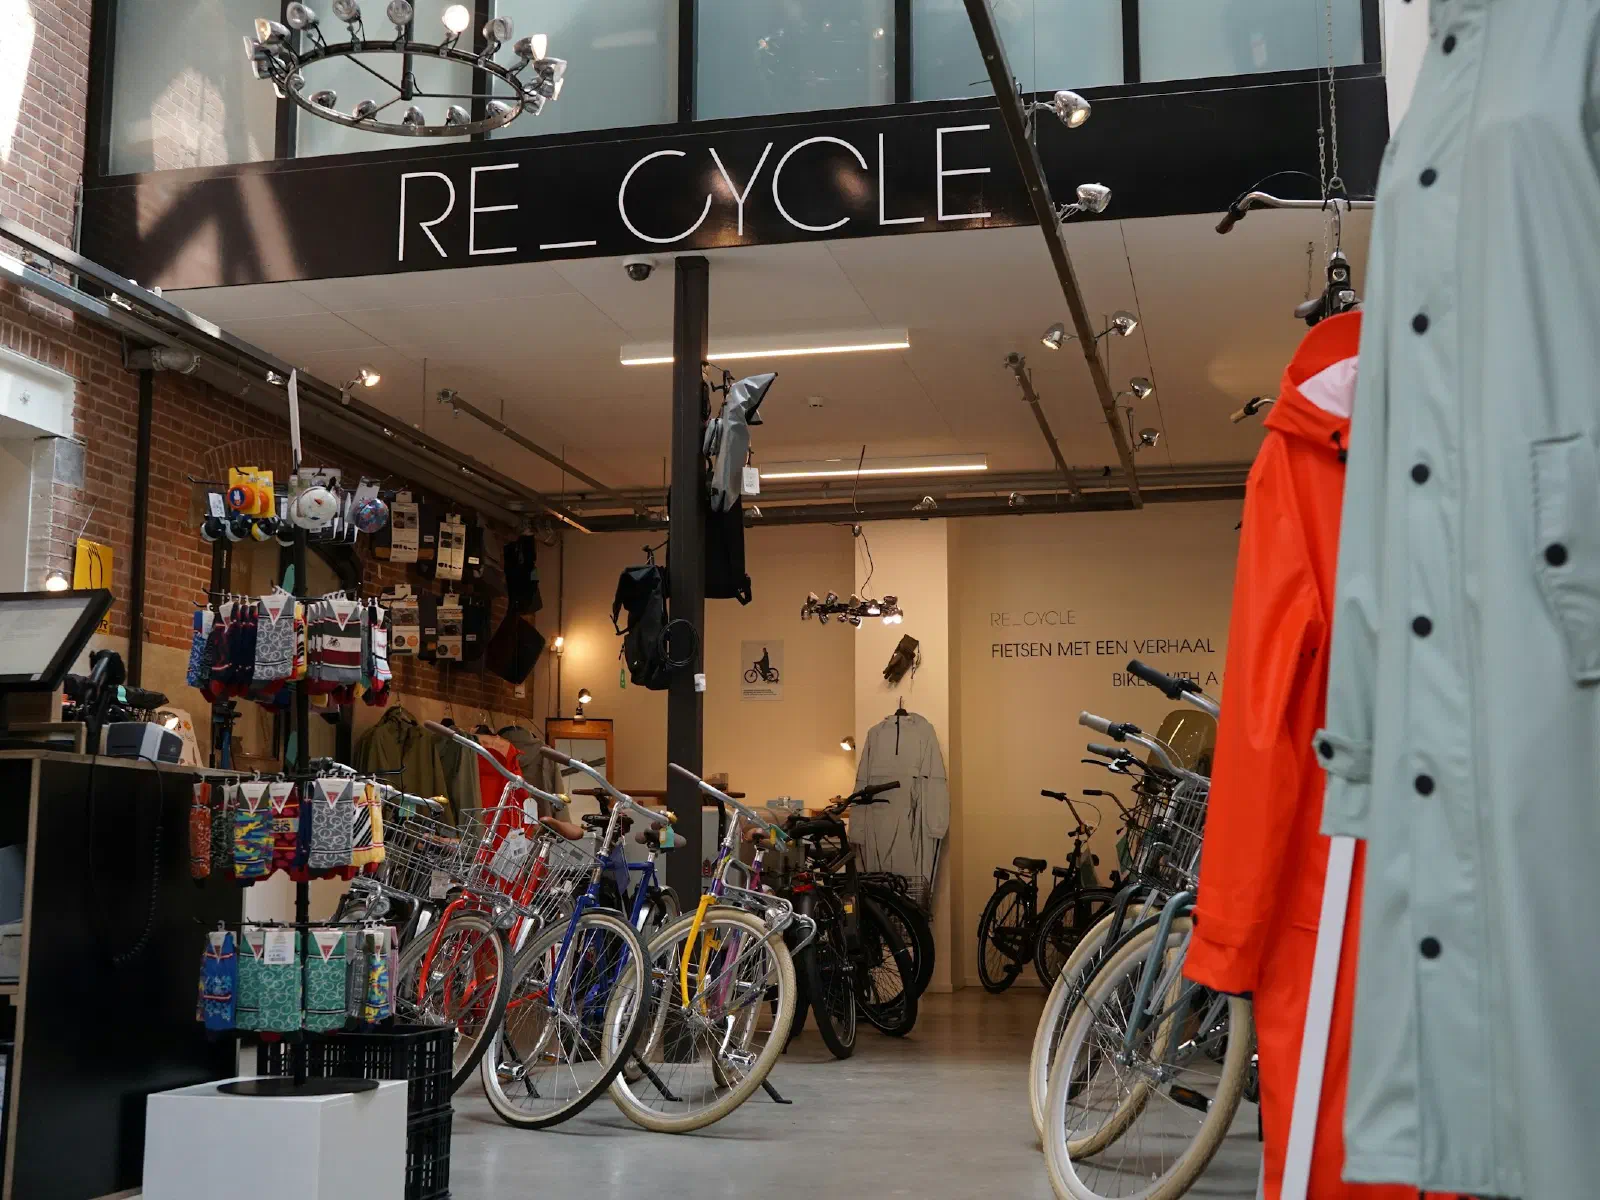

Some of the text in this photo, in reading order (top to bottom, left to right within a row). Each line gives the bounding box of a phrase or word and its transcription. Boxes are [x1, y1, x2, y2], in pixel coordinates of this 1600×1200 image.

[398, 124, 992, 261] RE_CYCLE
[990, 610, 1076, 626] RE_CYCLE
[991, 638, 1215, 658] FIETSEN MET EEN VERHAAL
[1205, 671, 1219, 685] A
